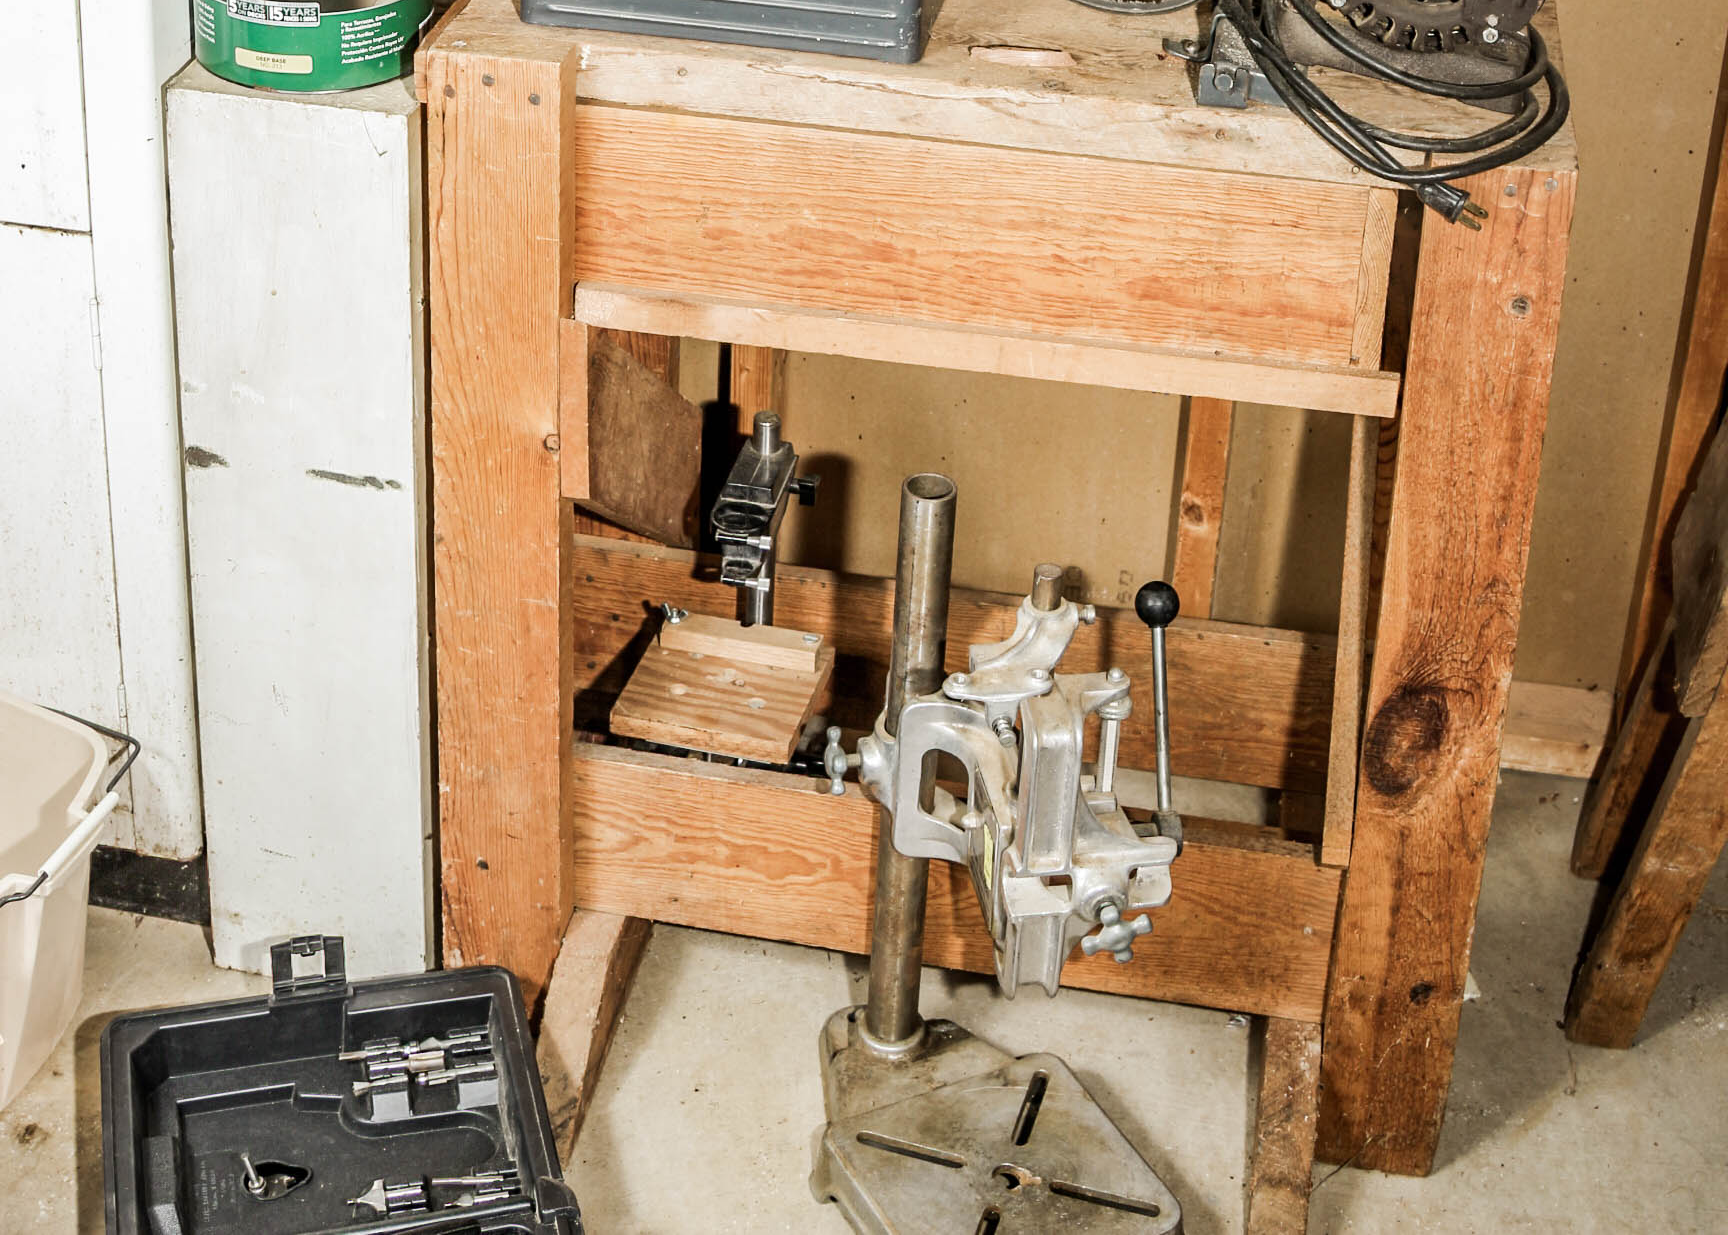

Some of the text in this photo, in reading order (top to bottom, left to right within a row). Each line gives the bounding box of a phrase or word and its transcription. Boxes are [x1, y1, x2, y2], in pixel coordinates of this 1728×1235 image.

[237, 0, 266, 15] YEARS
[269, 6, 318, 22] 15 YEARS
